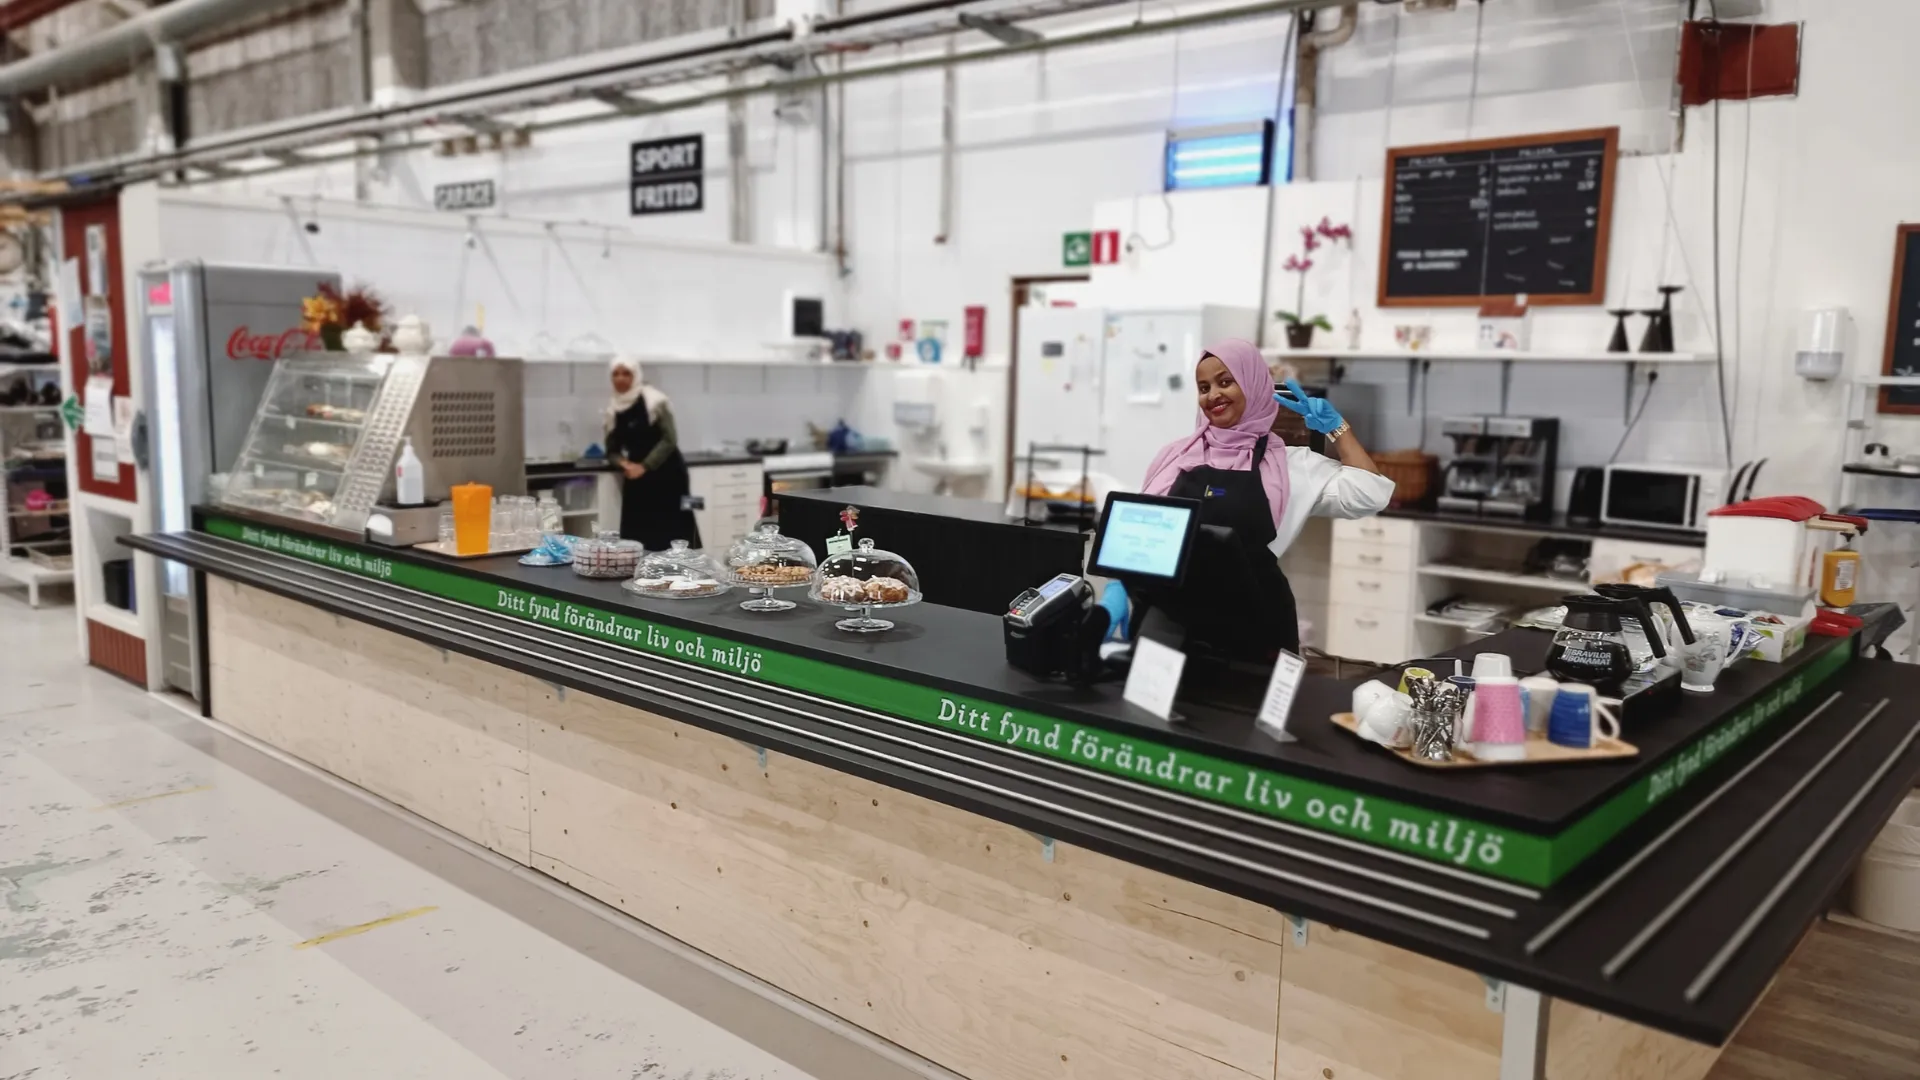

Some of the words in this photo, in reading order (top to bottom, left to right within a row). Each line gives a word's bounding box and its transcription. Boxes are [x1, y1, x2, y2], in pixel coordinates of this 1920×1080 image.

[635, 143, 697, 173] SPORT
[635, 183, 699, 210] FRITID
[242, 526, 260, 542] Ditt
[260, 529, 280, 547] fynd
[281, 534, 326, 558] förändrar
[328, 545, 343, 563] liv
[343, 552, 362, 569] och
[363, 558, 392, 578] miljö
[497, 590, 525, 612] Ditt
[529, 596, 560, 621] fynd
[563, 605, 642, 642] förändrar
[646, 625, 670, 649] liv
[674, 637, 706, 659] och
[712, 646, 762, 674] miljö
[1566, 656, 1611, 666] BONAMAT
[1571, 650, 1612, 659] BRAVILOR
[937, 698, 992, 732] Ditt
[998, 711, 1062, 751] fynd
[1070, 729, 1234, 795] förändrar
[1244, 771, 1293, 810] liv
[1305, 797, 1373, 832] och
[1388, 817, 1504, 866] miljö
